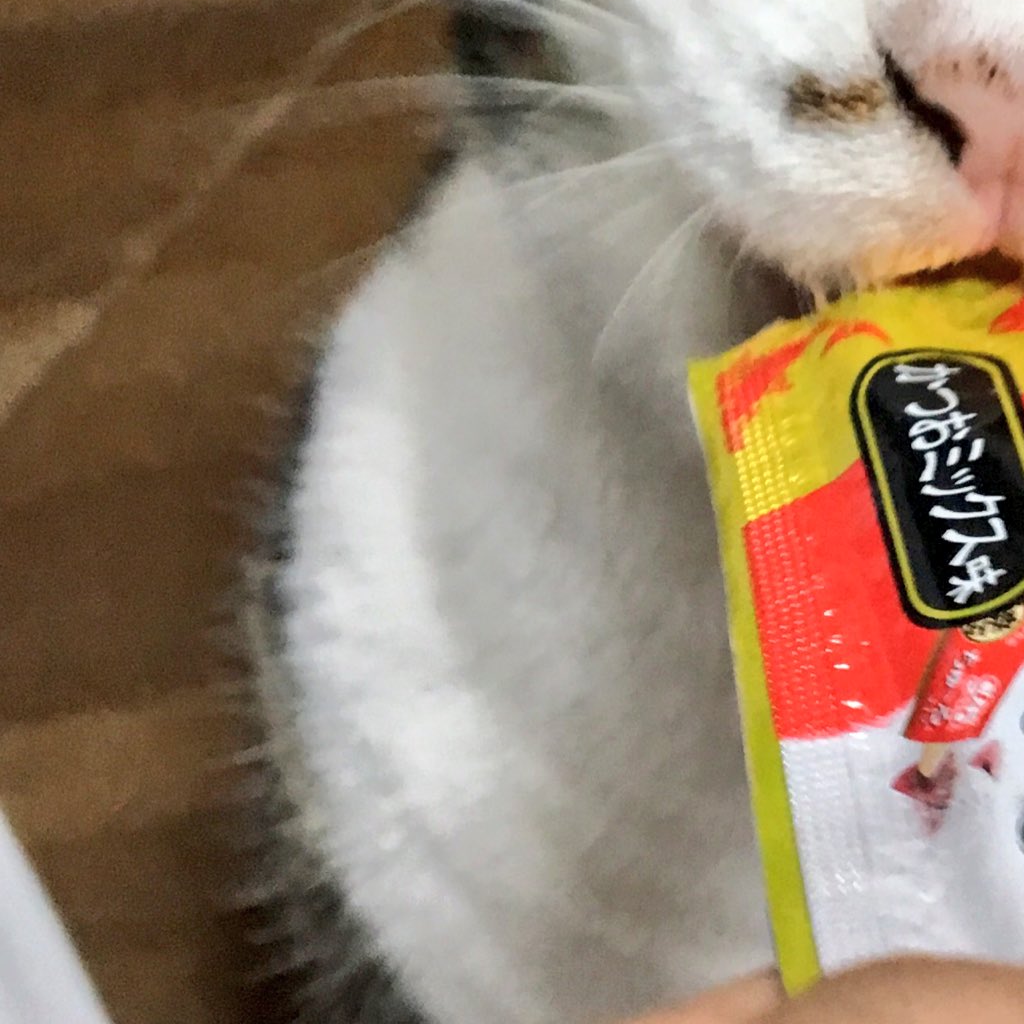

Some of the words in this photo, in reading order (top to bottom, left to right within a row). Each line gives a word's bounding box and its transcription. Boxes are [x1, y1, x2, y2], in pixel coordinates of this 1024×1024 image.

[893, 364, 1007, 604] かつおミックス味
